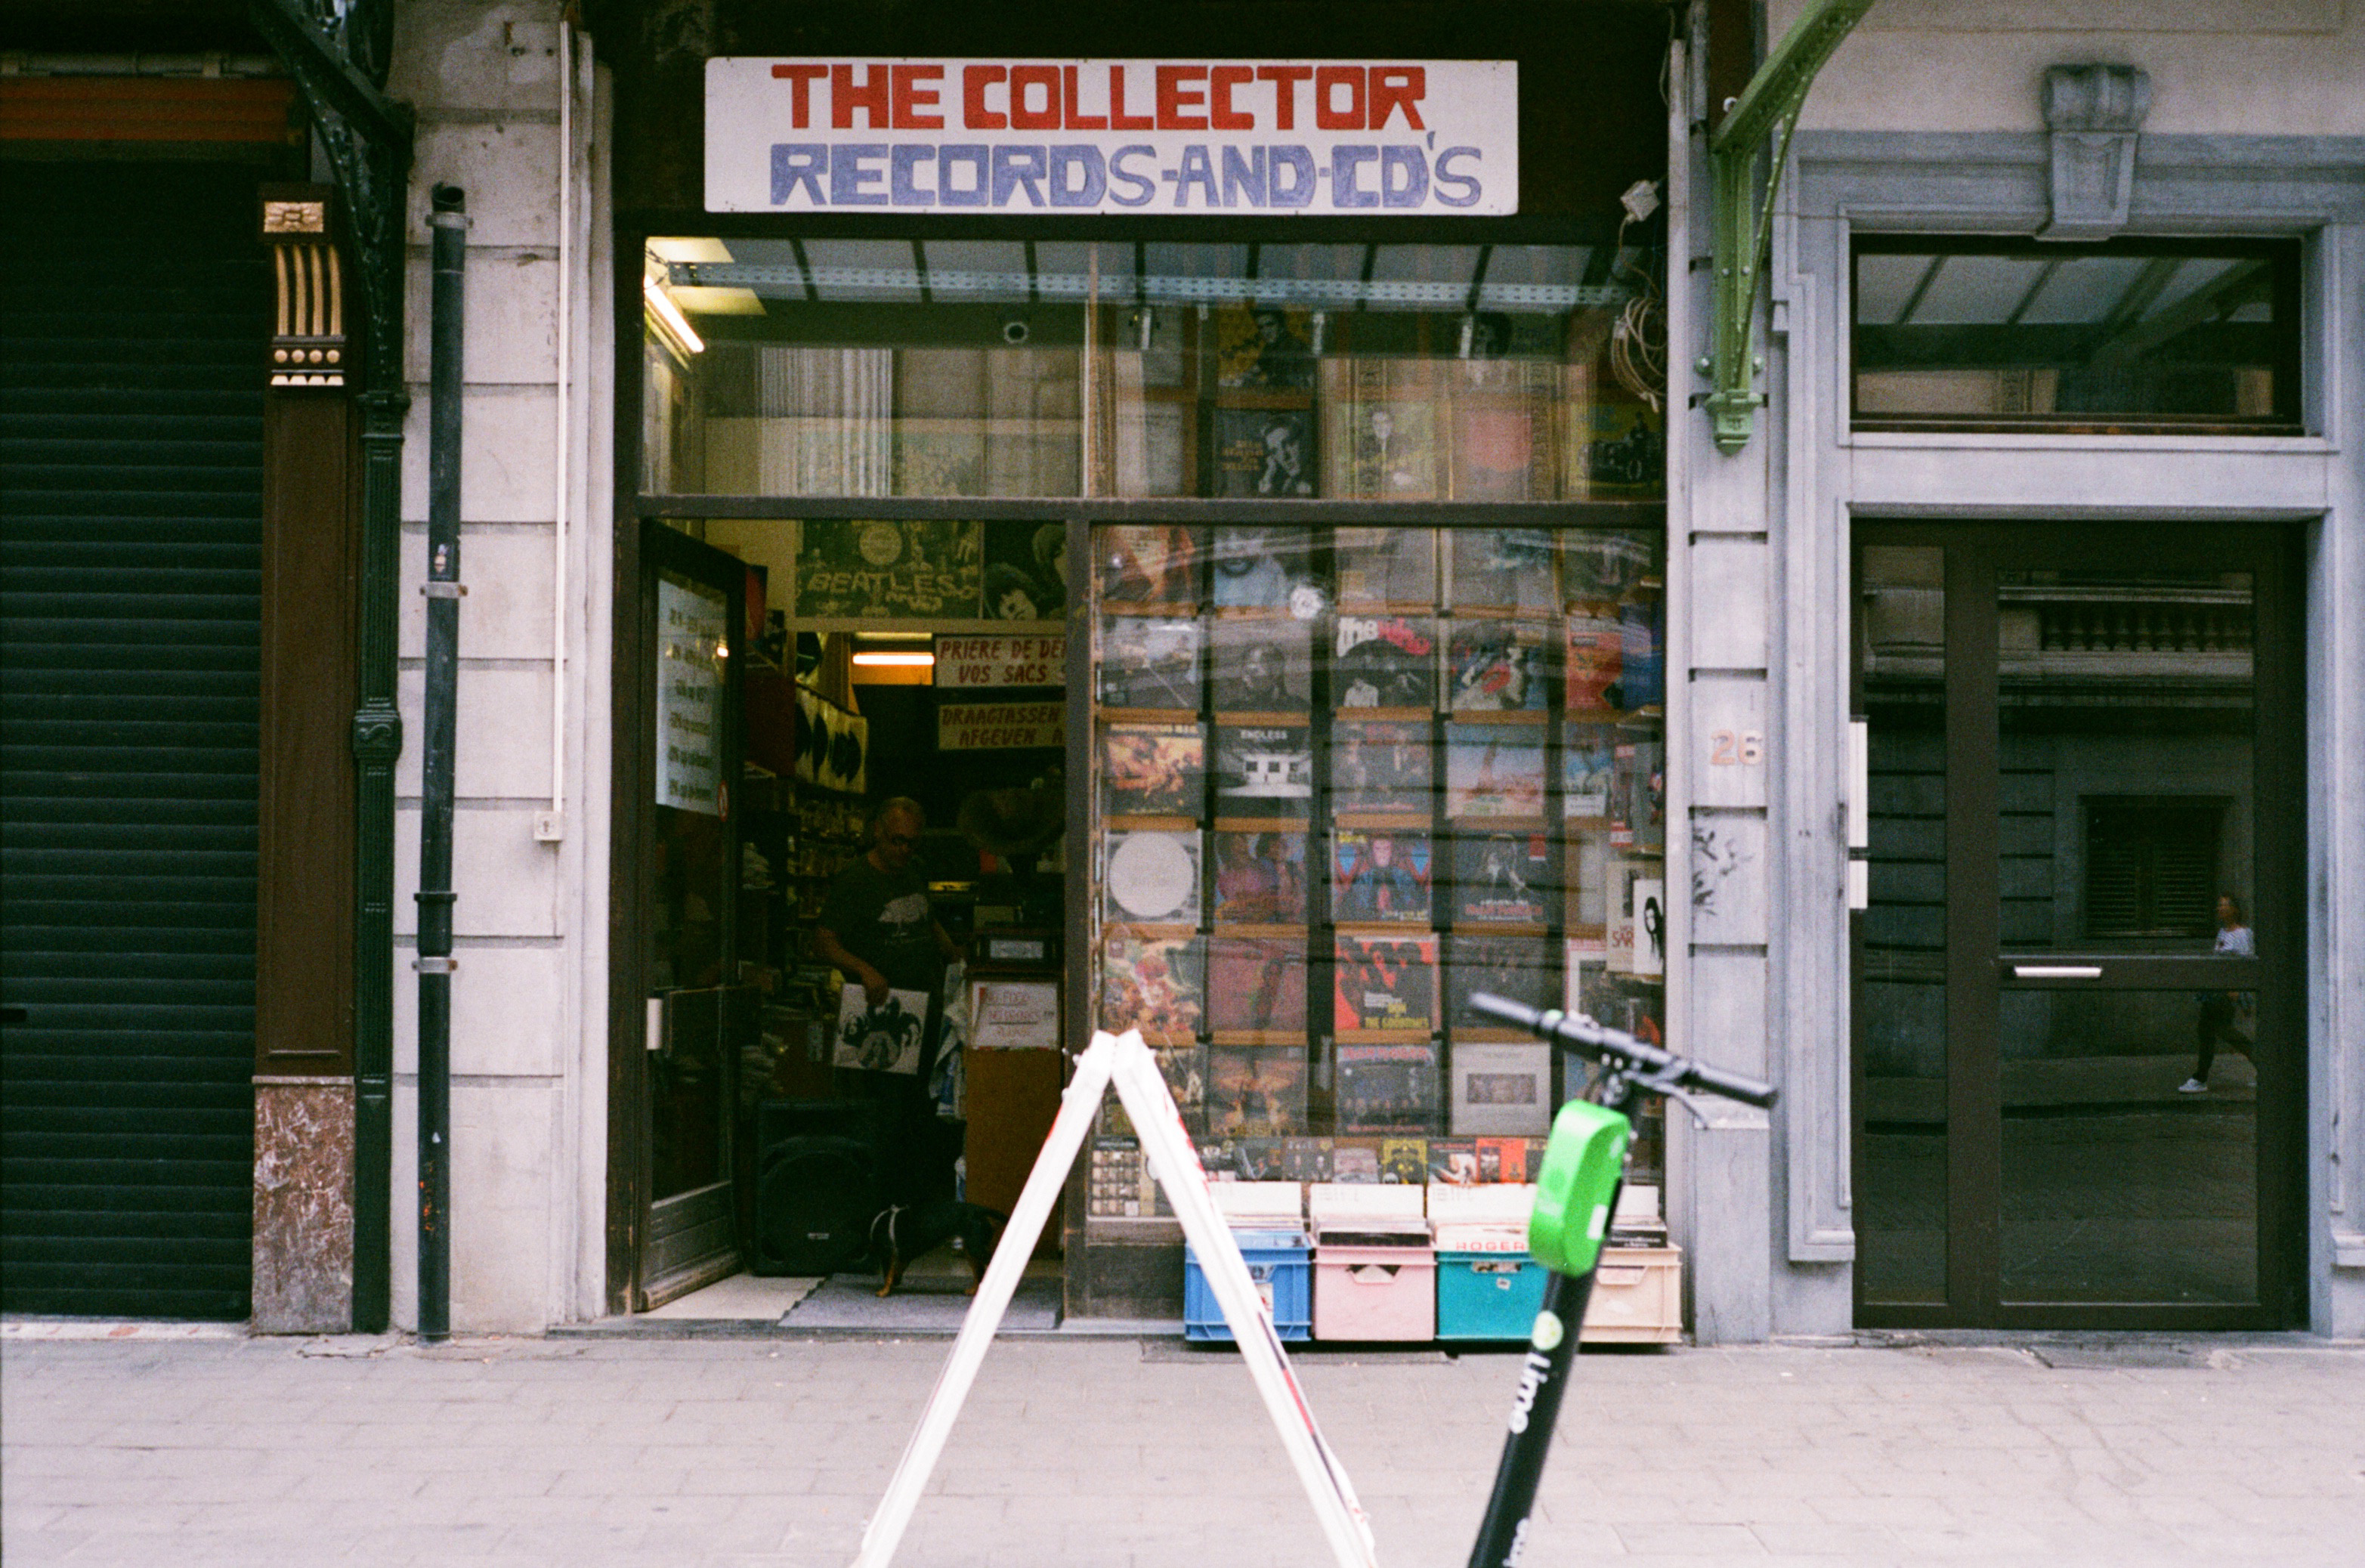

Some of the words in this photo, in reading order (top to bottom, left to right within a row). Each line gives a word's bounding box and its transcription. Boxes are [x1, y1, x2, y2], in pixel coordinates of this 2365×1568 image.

[771, 64, 944, 129] THE
[963, 65, 1427, 130] COLLECTOR
[807, 571, 957, 598] BEATLES
[940, 640, 1001, 660] PRIERE
[1011, 640, 1031, 660] DE
[958, 664, 991, 683] VOS
[1003, 663, 1048, 683] SACS
[1710, 728, 1764, 766] 26
[1508, 1352, 1551, 1434] Lime
